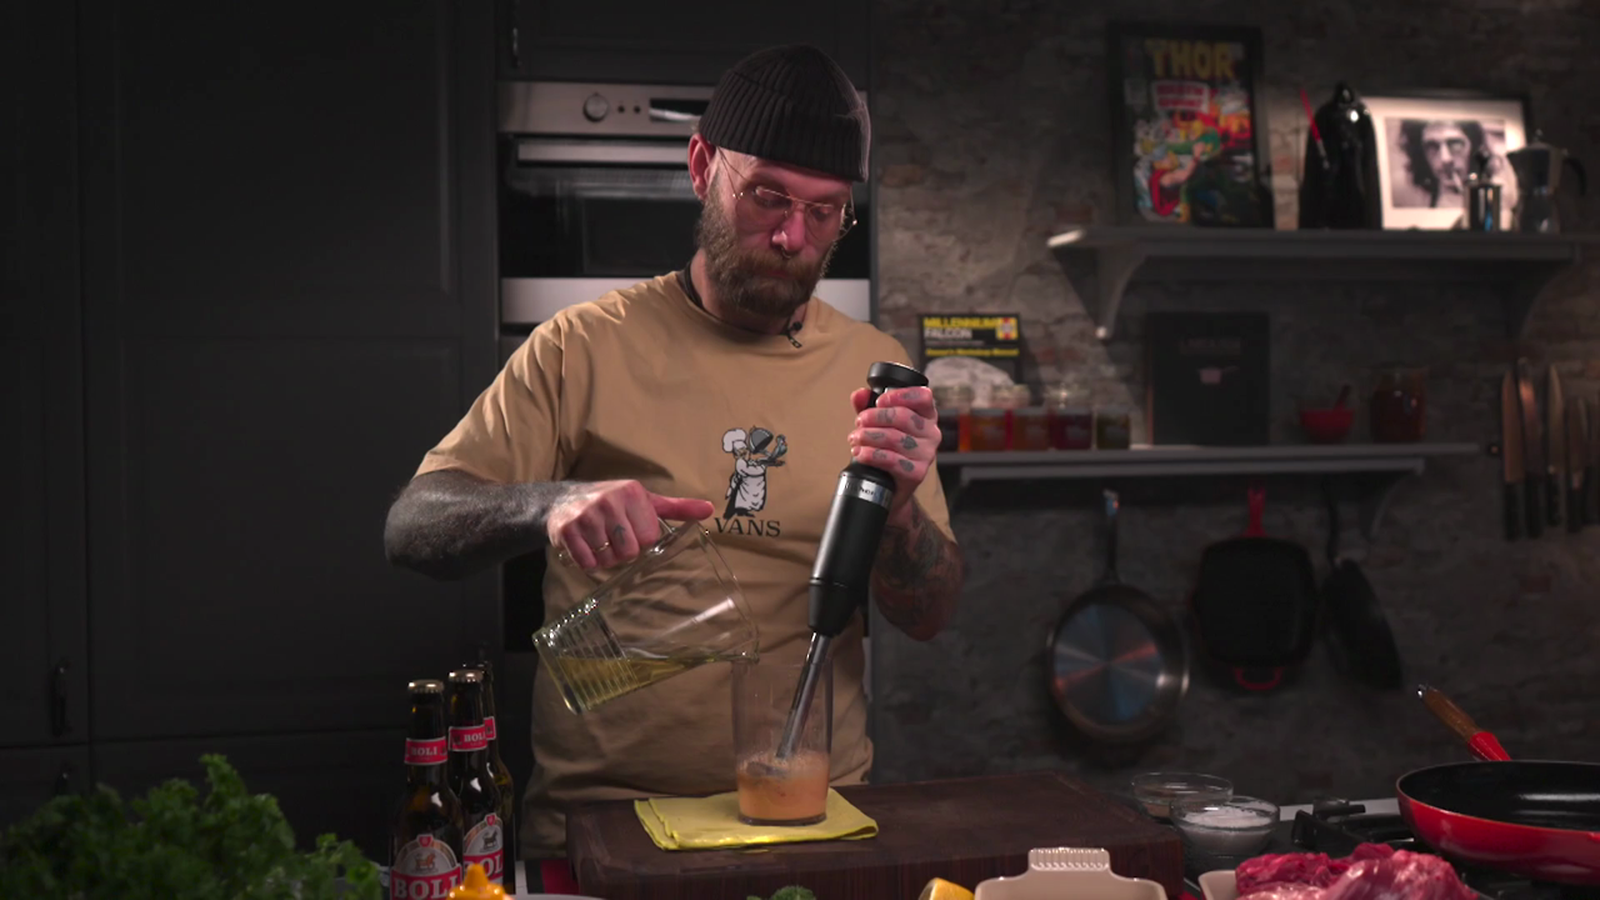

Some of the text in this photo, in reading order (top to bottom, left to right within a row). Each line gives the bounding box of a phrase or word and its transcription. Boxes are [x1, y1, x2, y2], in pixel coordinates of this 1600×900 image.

[1143, 39, 1234, 78] THOR
[925, 328, 972, 339] FALCON
[715, 518, 781, 538] VANS
[411, 746, 438, 756] BOLI
